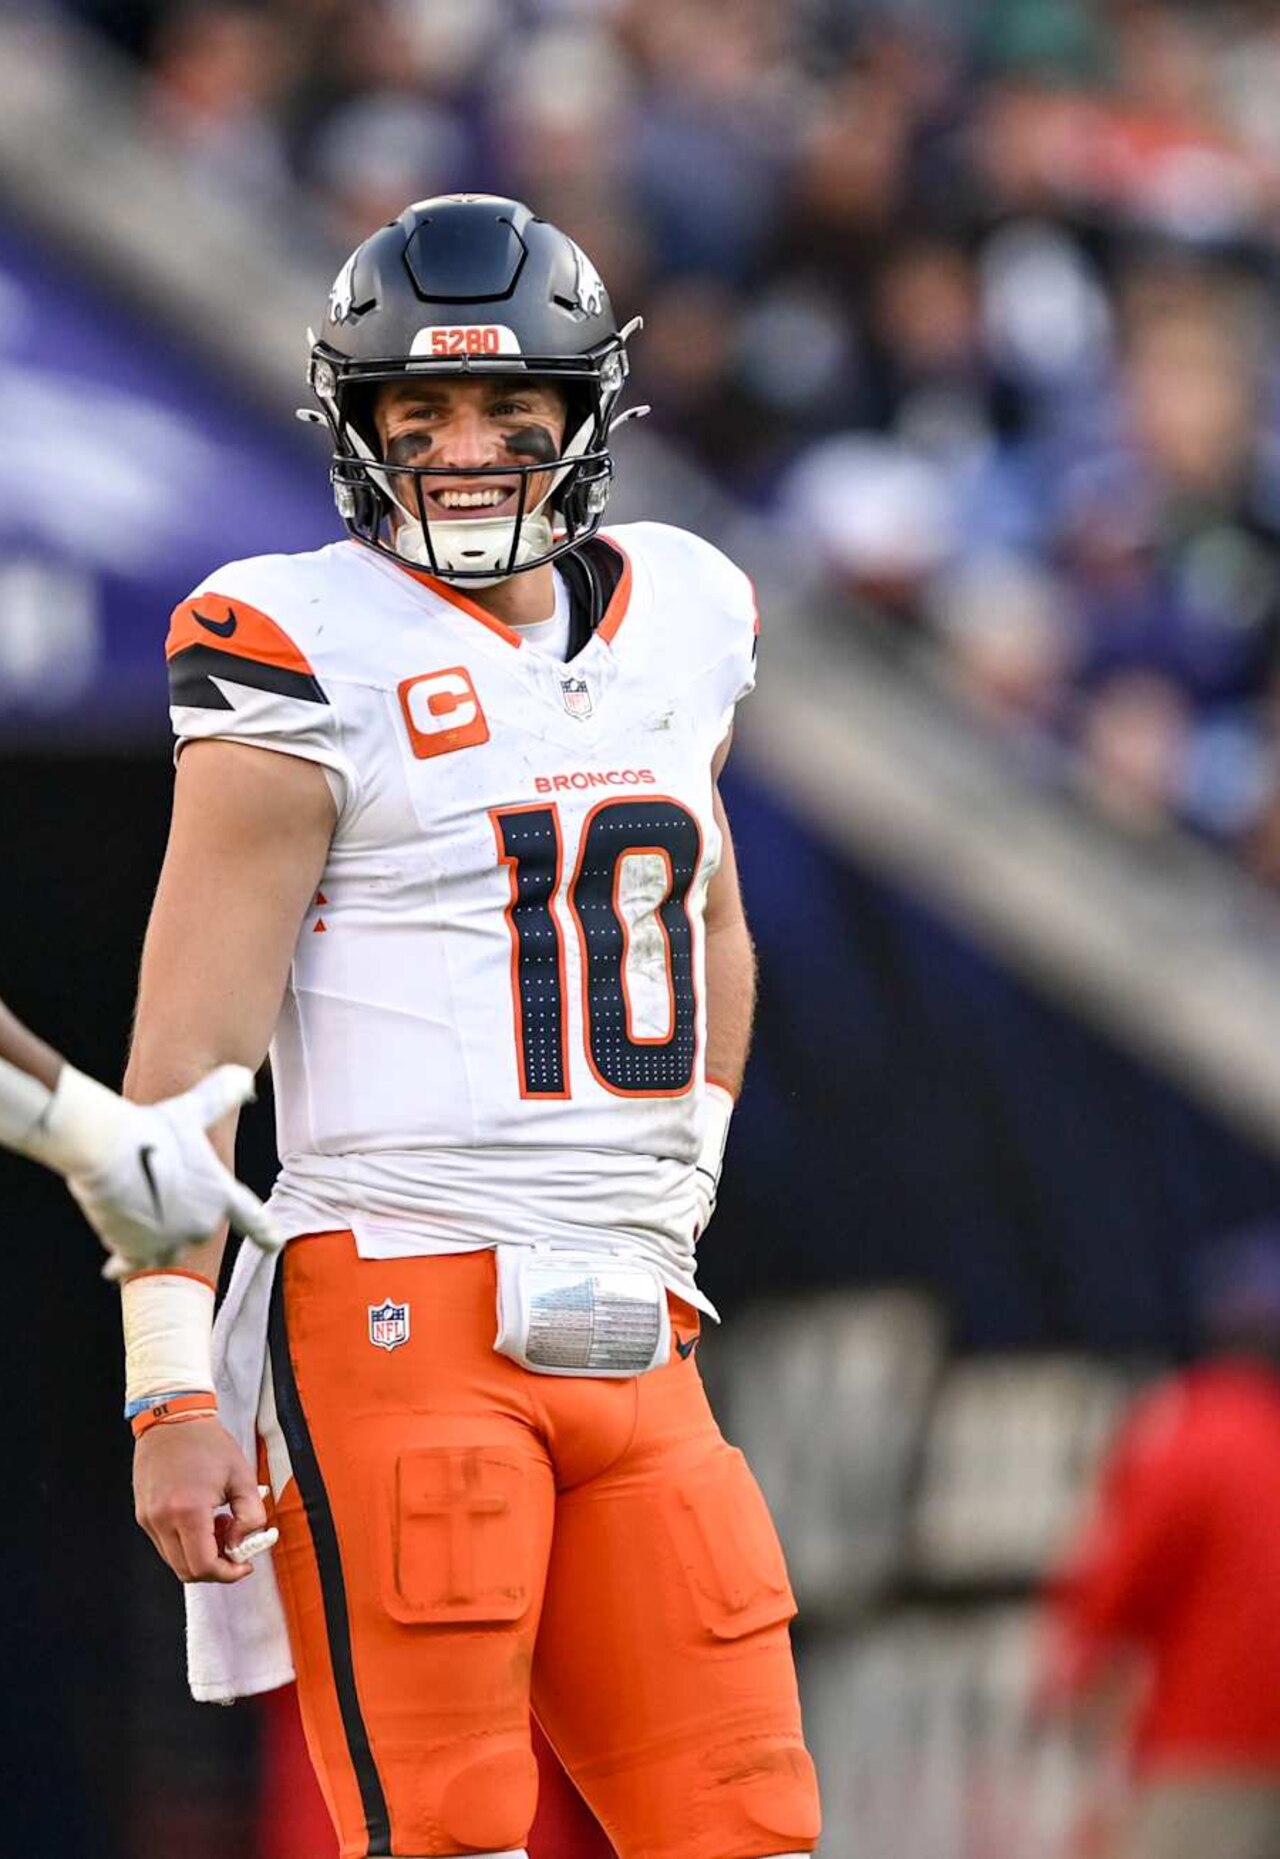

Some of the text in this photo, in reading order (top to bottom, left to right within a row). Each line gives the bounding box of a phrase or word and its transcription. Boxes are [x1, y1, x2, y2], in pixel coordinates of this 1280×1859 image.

[431, 327, 500, 356] 5280
[407, 673, 477, 735] C
[534, 769, 657, 793] BRONCOS
[487, 795, 704, 1101] 10
[375, 1321, 403, 1341] NFL
